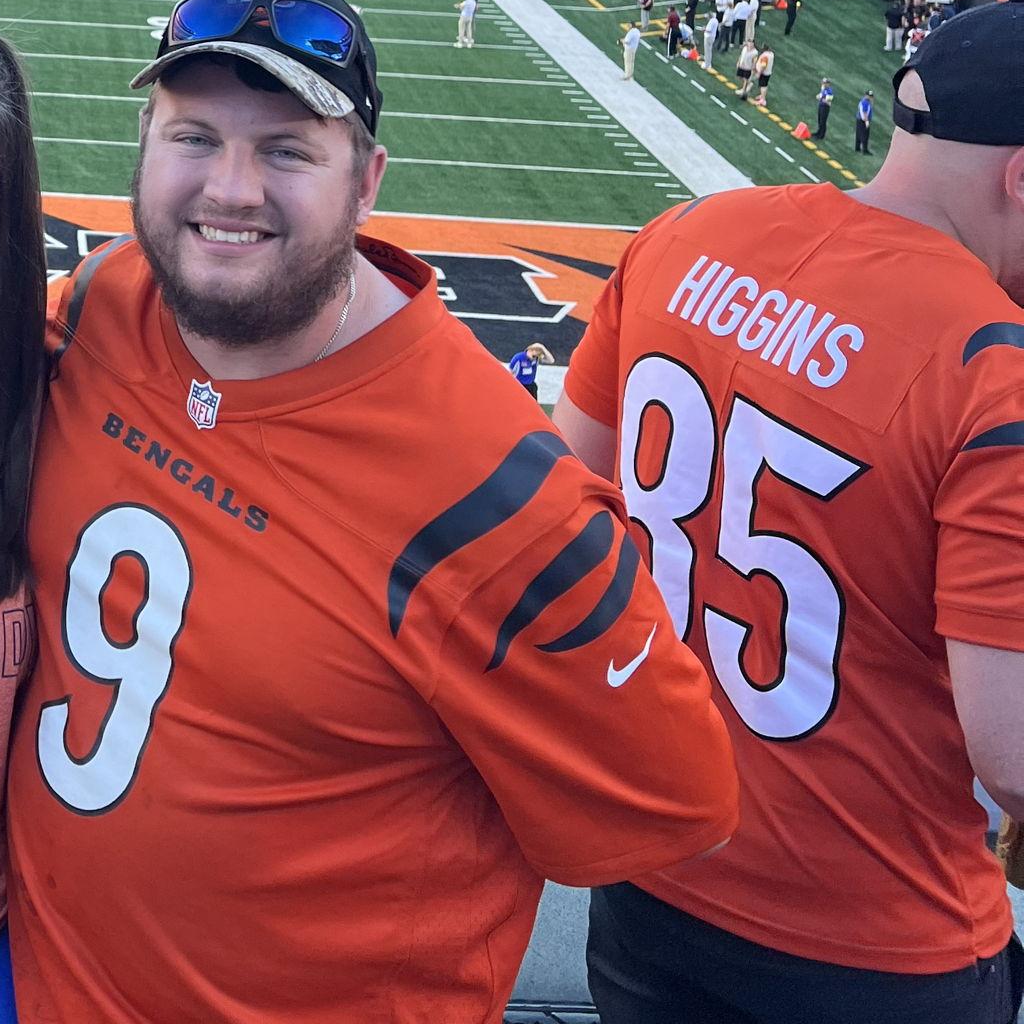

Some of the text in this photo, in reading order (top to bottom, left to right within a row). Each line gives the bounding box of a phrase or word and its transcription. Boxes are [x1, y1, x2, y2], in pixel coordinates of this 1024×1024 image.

[666, 254, 865, 389] HIGGINS
[101, 412, 270, 534] BENGALS
[190, 398, 211, 423] NFL
[619, 351, 873, 742] 85
[36, 501, 193, 817] 9
